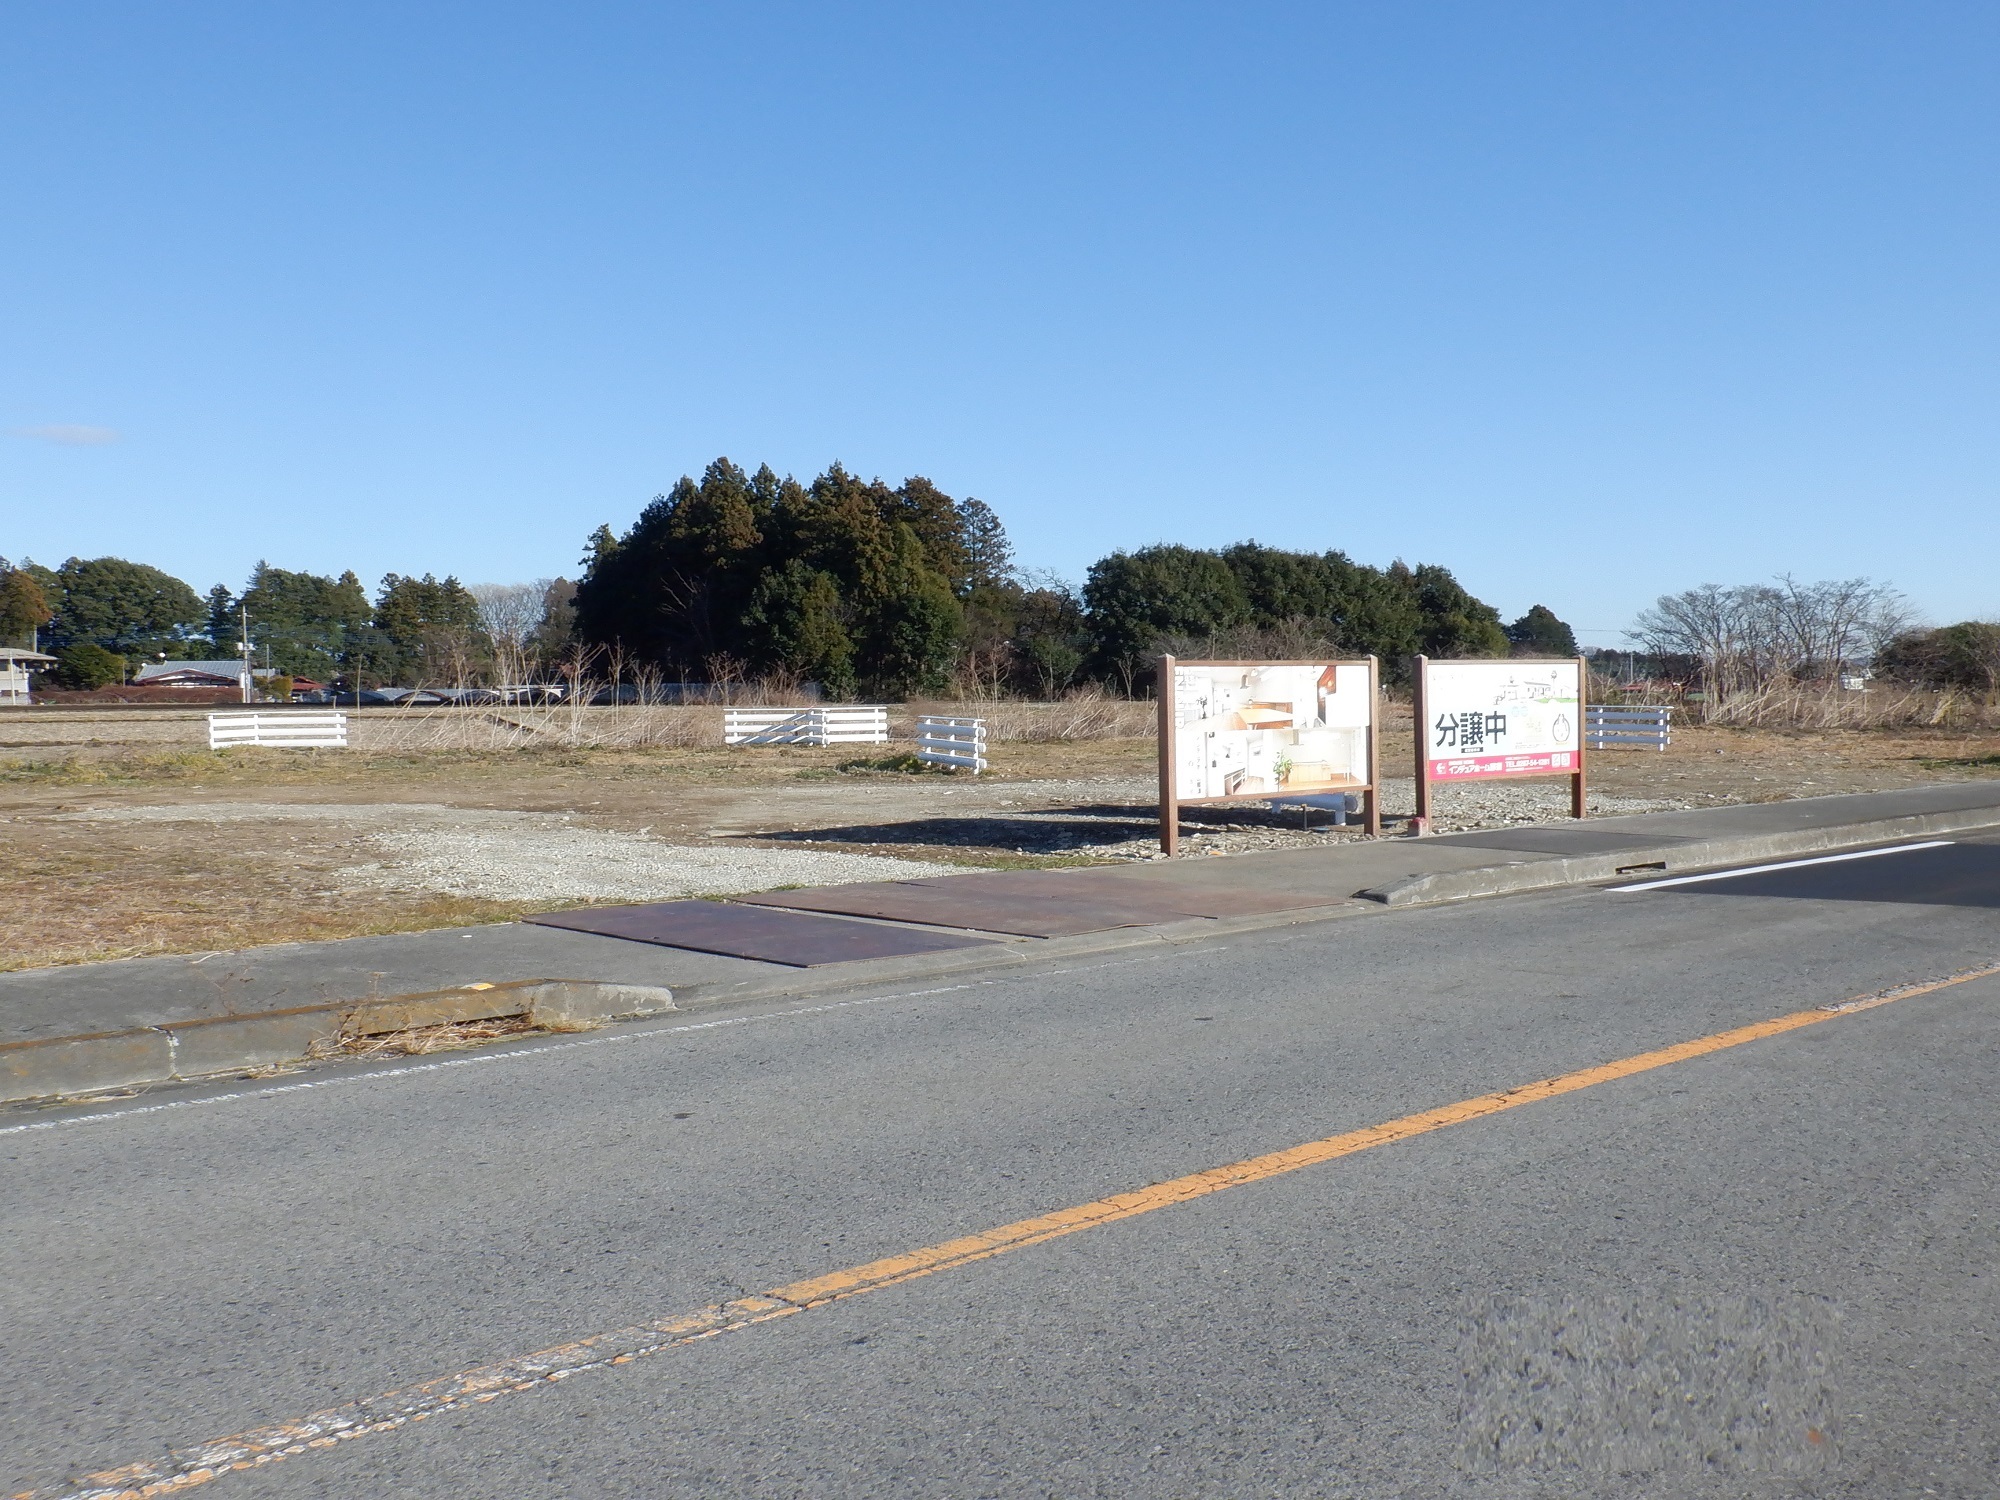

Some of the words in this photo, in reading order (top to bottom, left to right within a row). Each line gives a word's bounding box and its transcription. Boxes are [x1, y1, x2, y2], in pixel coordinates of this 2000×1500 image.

[1435, 711, 1507, 748] 分譲中
[1448, 763, 1503, 775] インデュアホーム
